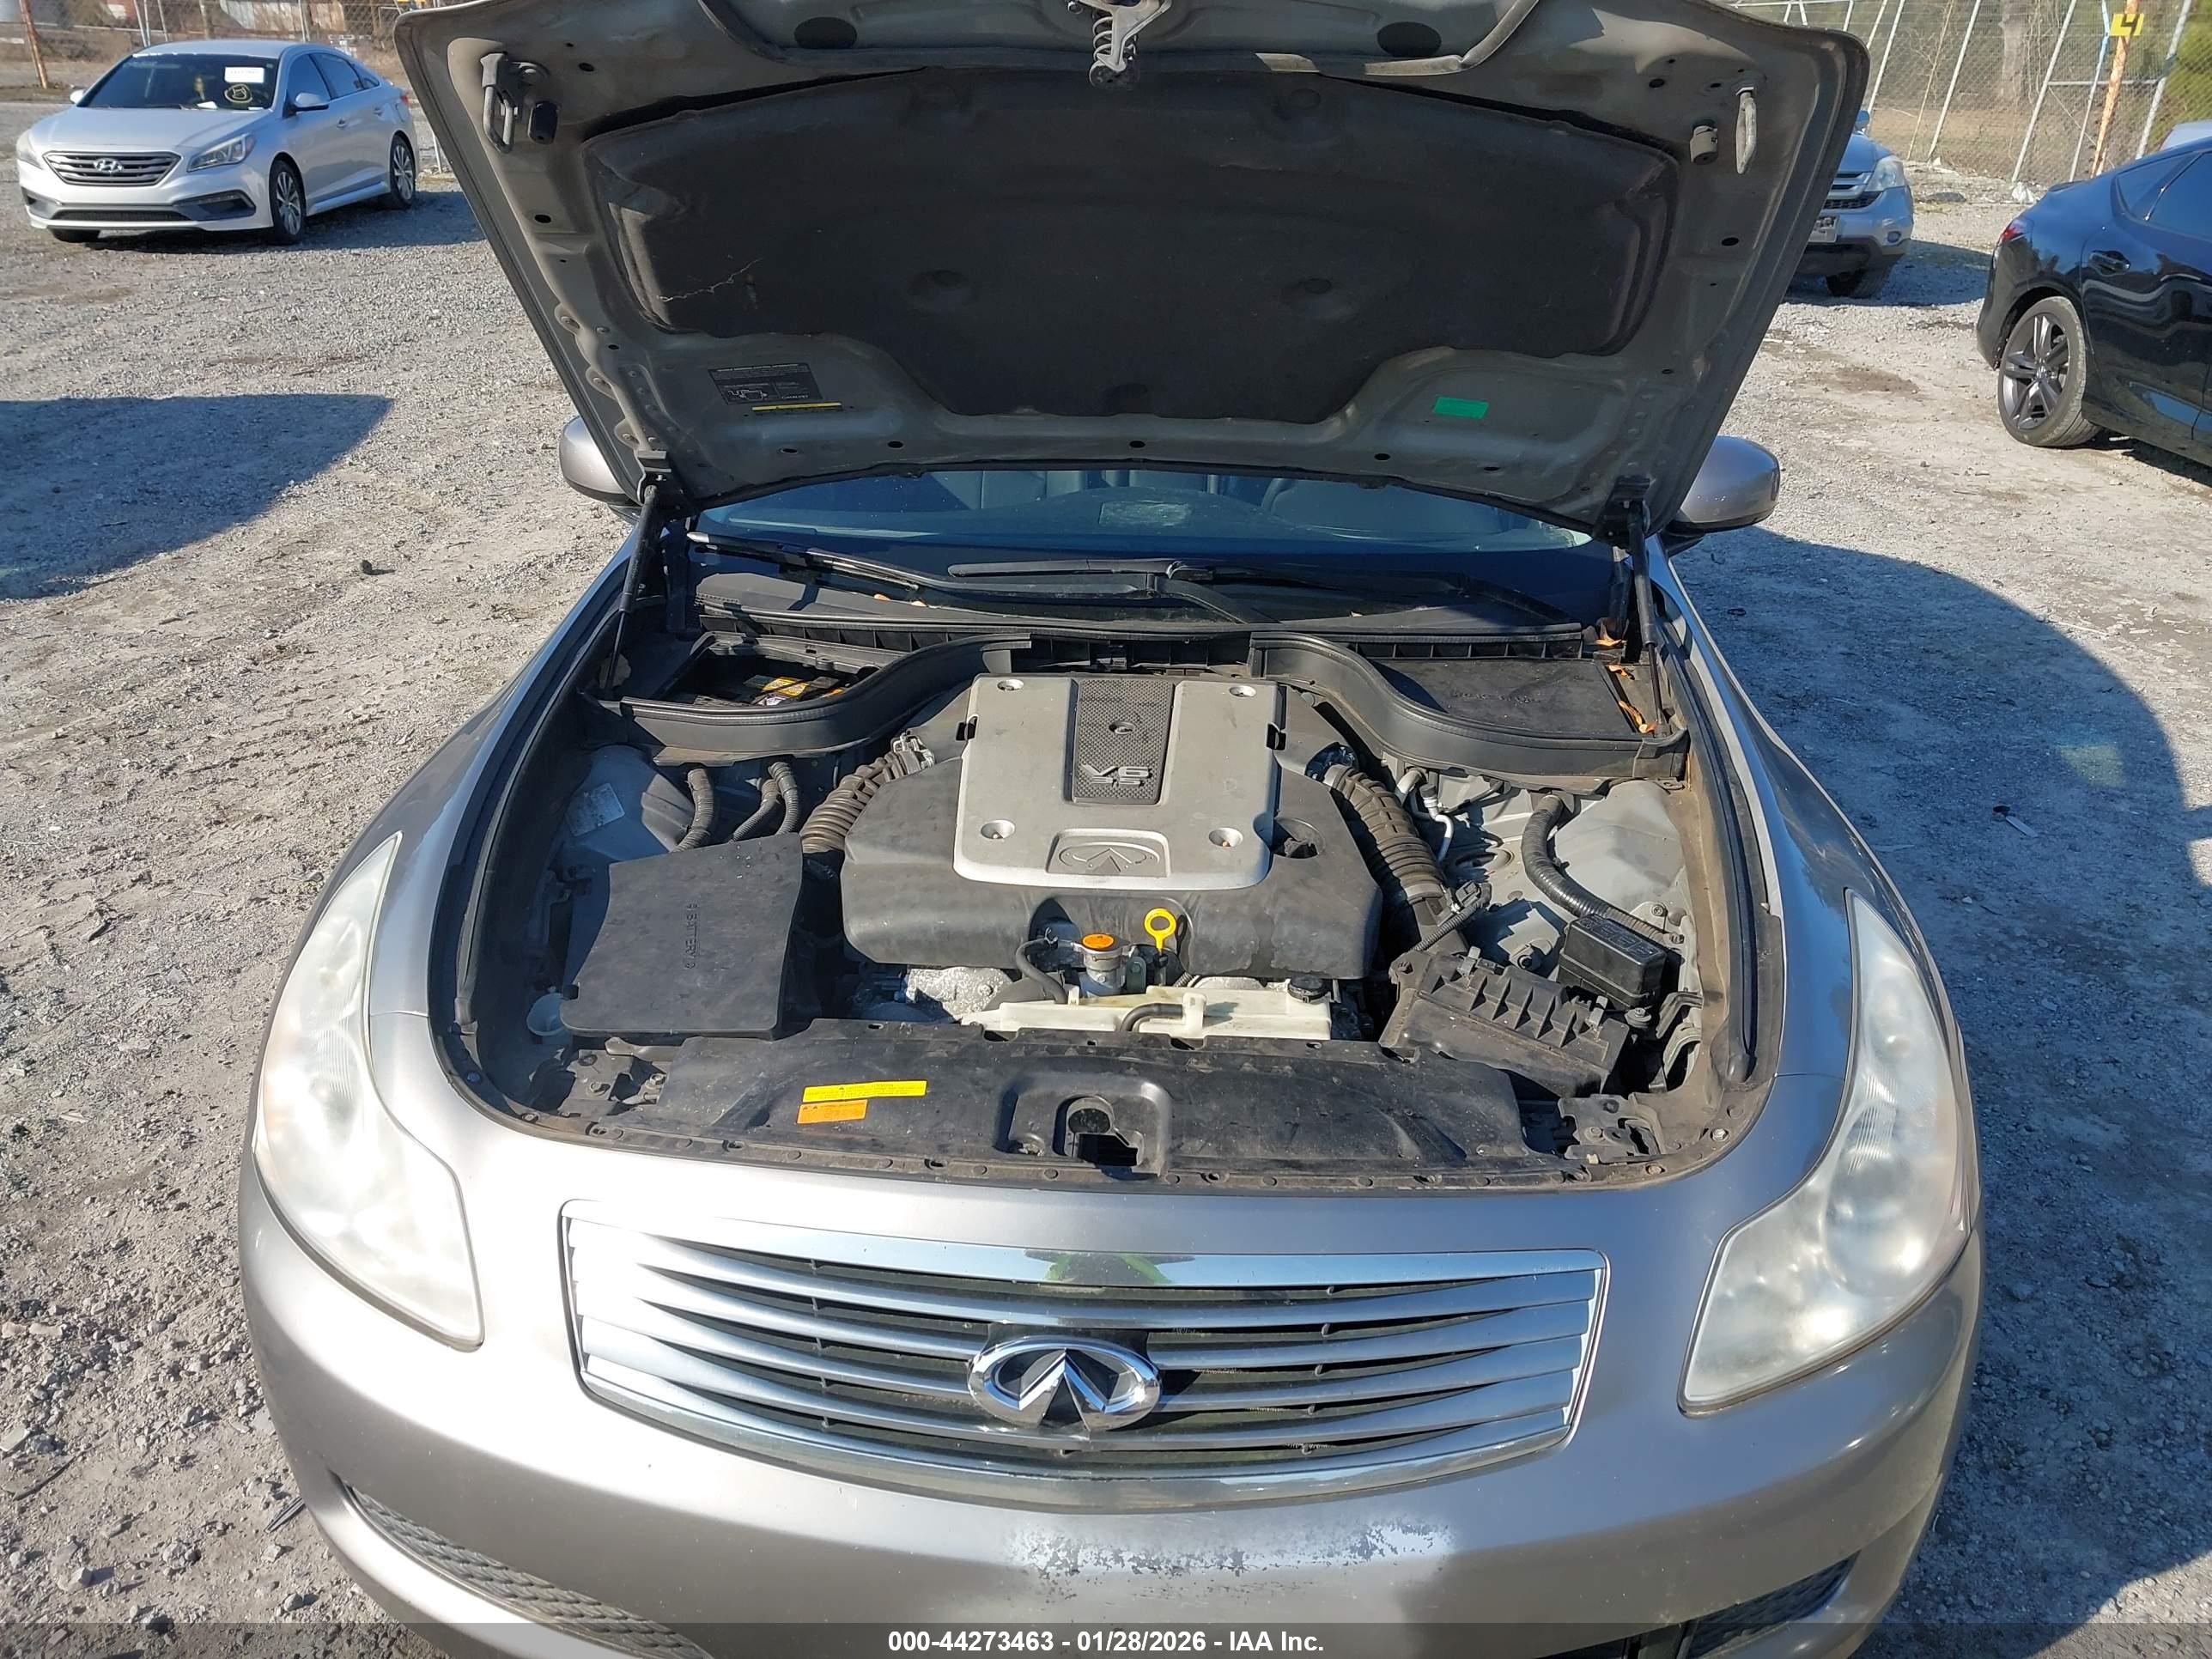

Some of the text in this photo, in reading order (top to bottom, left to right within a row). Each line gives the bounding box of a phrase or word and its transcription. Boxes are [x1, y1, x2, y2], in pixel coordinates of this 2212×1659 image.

[2120, 14, 2140, 36] 4
[1080, 763, 1149, 777] V6
[685, 913, 697, 958] BATTERY
